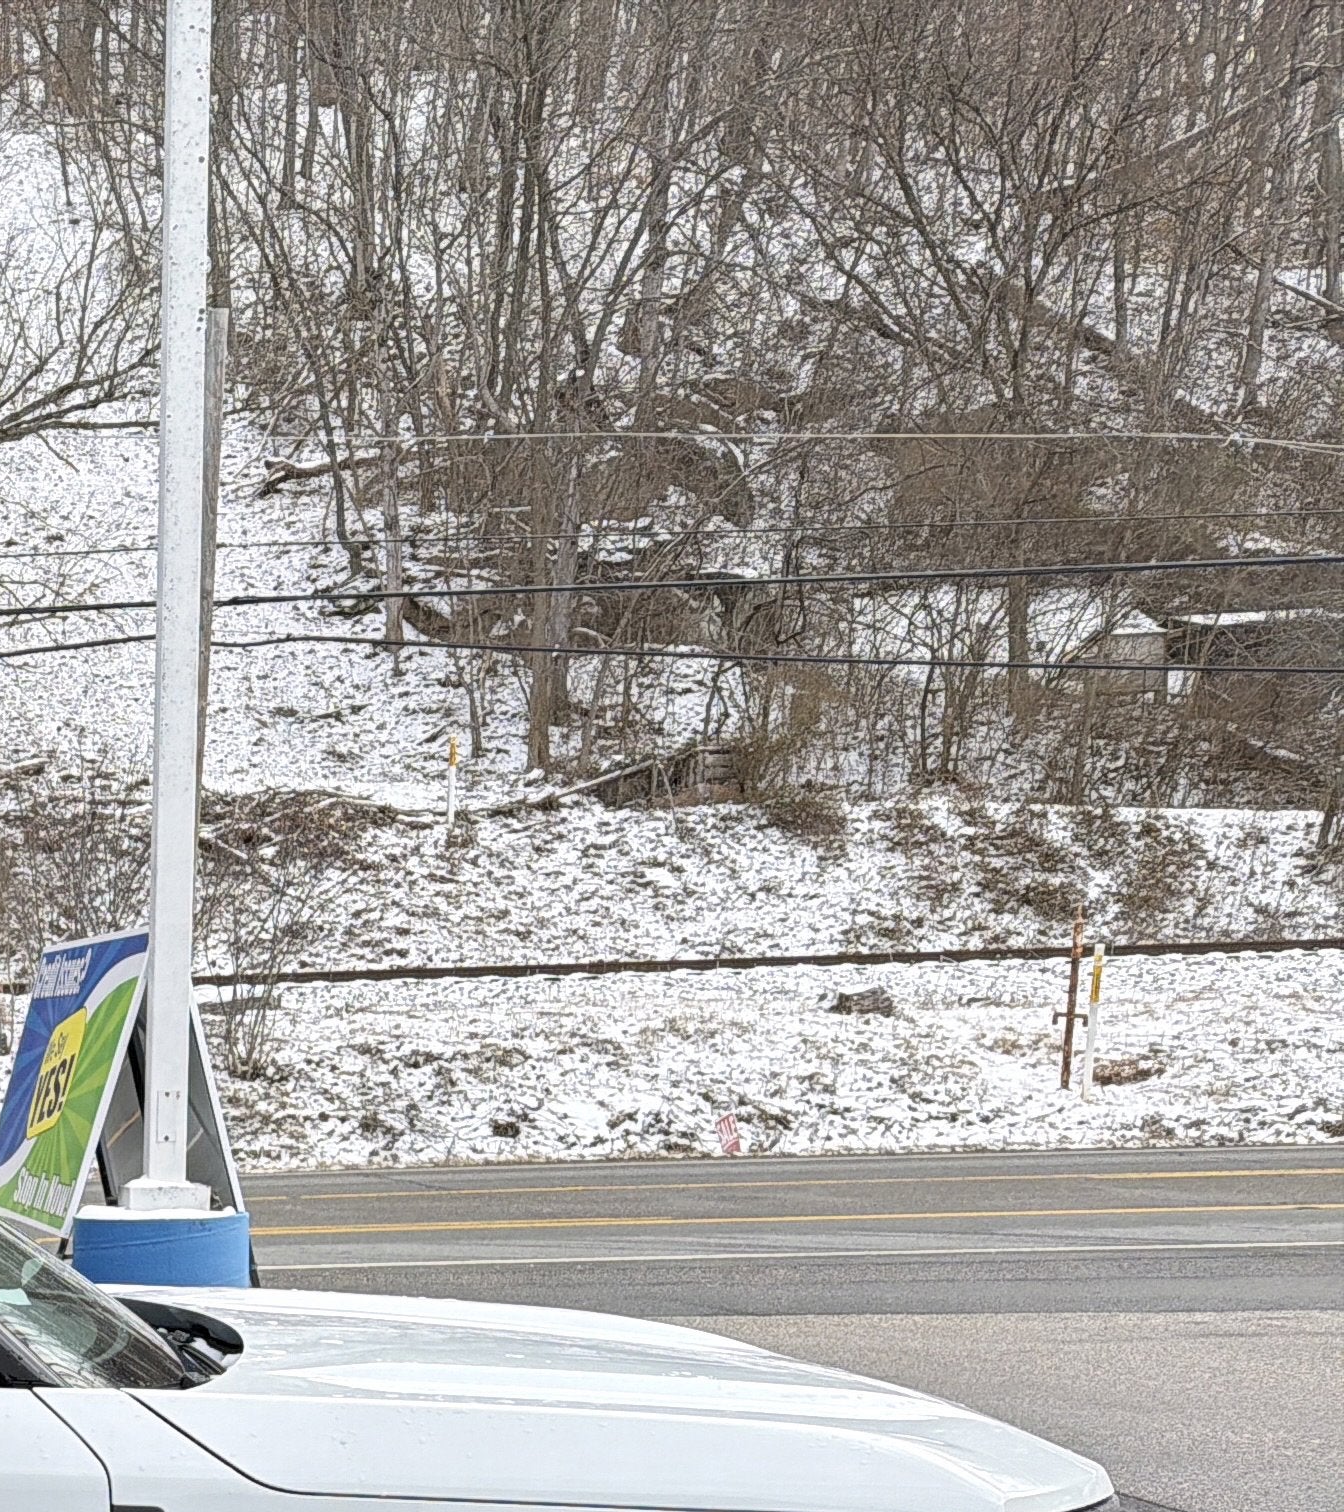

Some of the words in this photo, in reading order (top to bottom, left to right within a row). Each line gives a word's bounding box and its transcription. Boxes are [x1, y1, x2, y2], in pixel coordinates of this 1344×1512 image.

[30, 1053, 76, 1128] YES!
[13, 1166, 39, 1209] Stop
[44, 1174, 76, 1217] Now!
